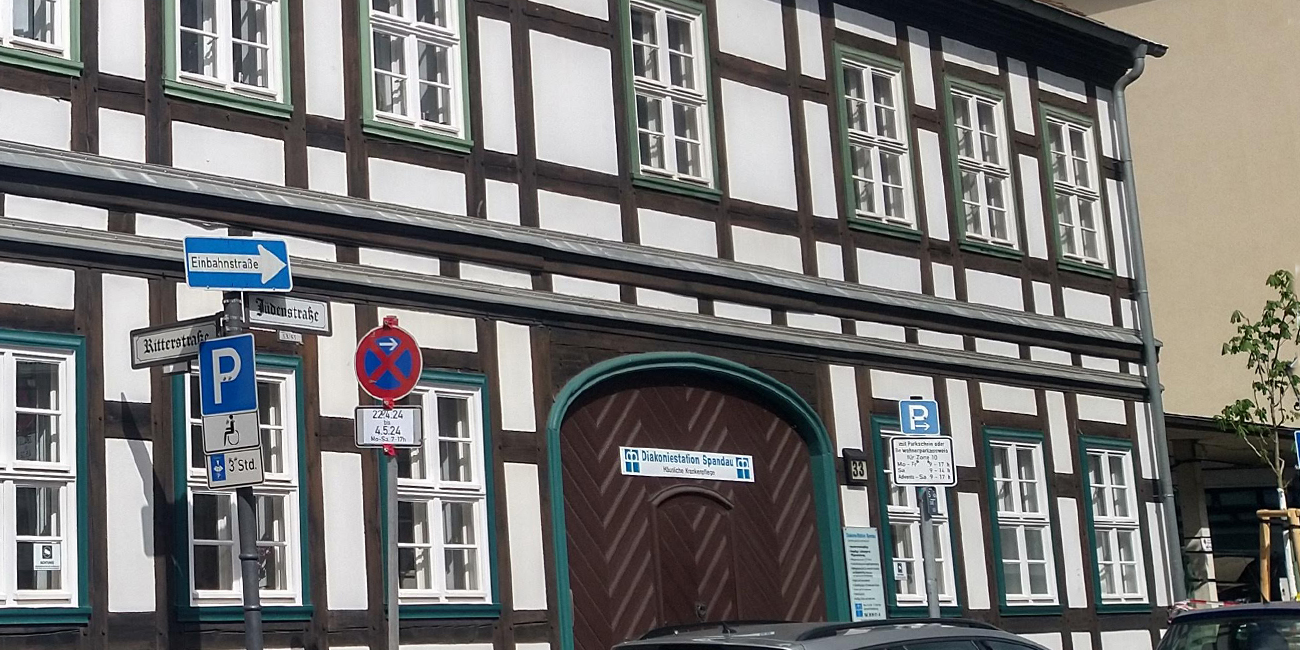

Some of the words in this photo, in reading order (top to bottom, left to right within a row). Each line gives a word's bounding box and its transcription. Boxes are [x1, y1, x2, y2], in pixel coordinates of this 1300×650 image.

[191, 256, 259, 269] Einbahnstraße
[256, 297, 319, 323] Jüdenstraße
[211, 347, 241, 404] P
[909, 404, 929, 430] P
[375, 426, 401, 435] 4.5.24
[229, 459, 235, 472] 3
[238, 458, 257, 472] Std.
[641, 450, 700, 465] Diakoniestation
[702, 454, 734, 468] Spandau
[852, 461, 865, 477] 33
